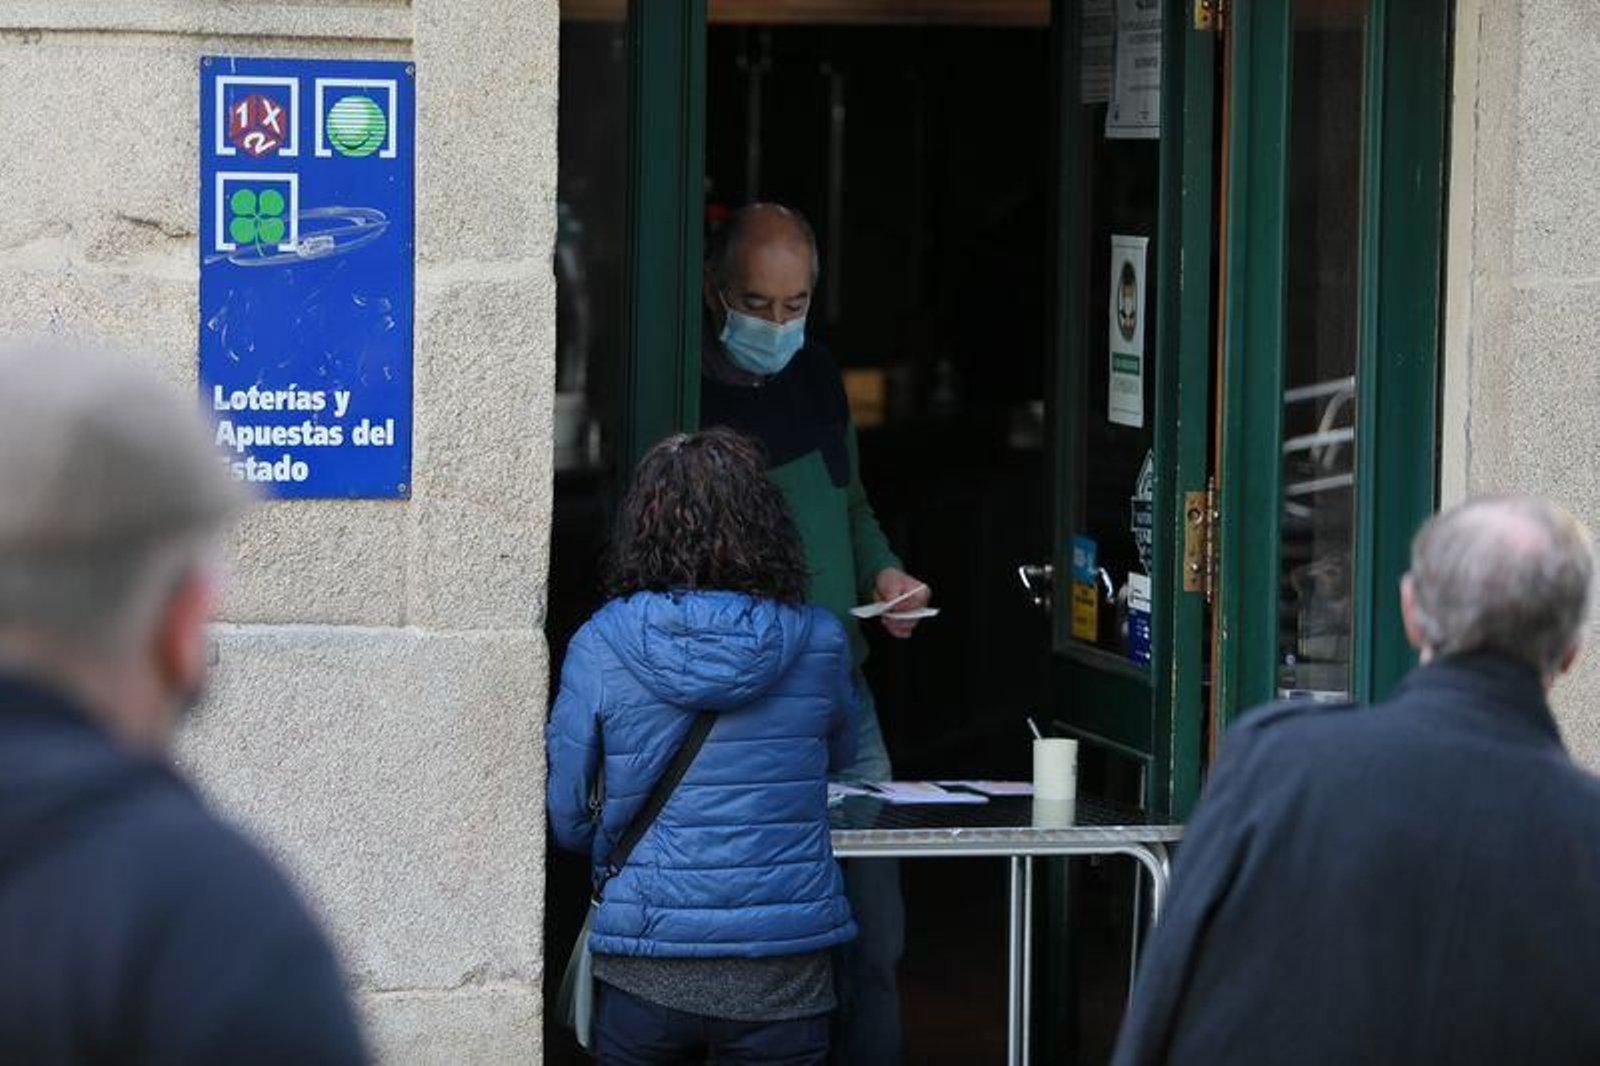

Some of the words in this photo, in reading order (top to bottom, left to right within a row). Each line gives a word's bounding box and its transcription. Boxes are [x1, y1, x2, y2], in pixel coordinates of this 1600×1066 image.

[214, 383, 326, 411] Loterías
[333, 390, 350, 417] y
[215, 419, 344, 453] Apuestas
[352, 418, 394, 446] del
[222, 454, 309, 482] stado
